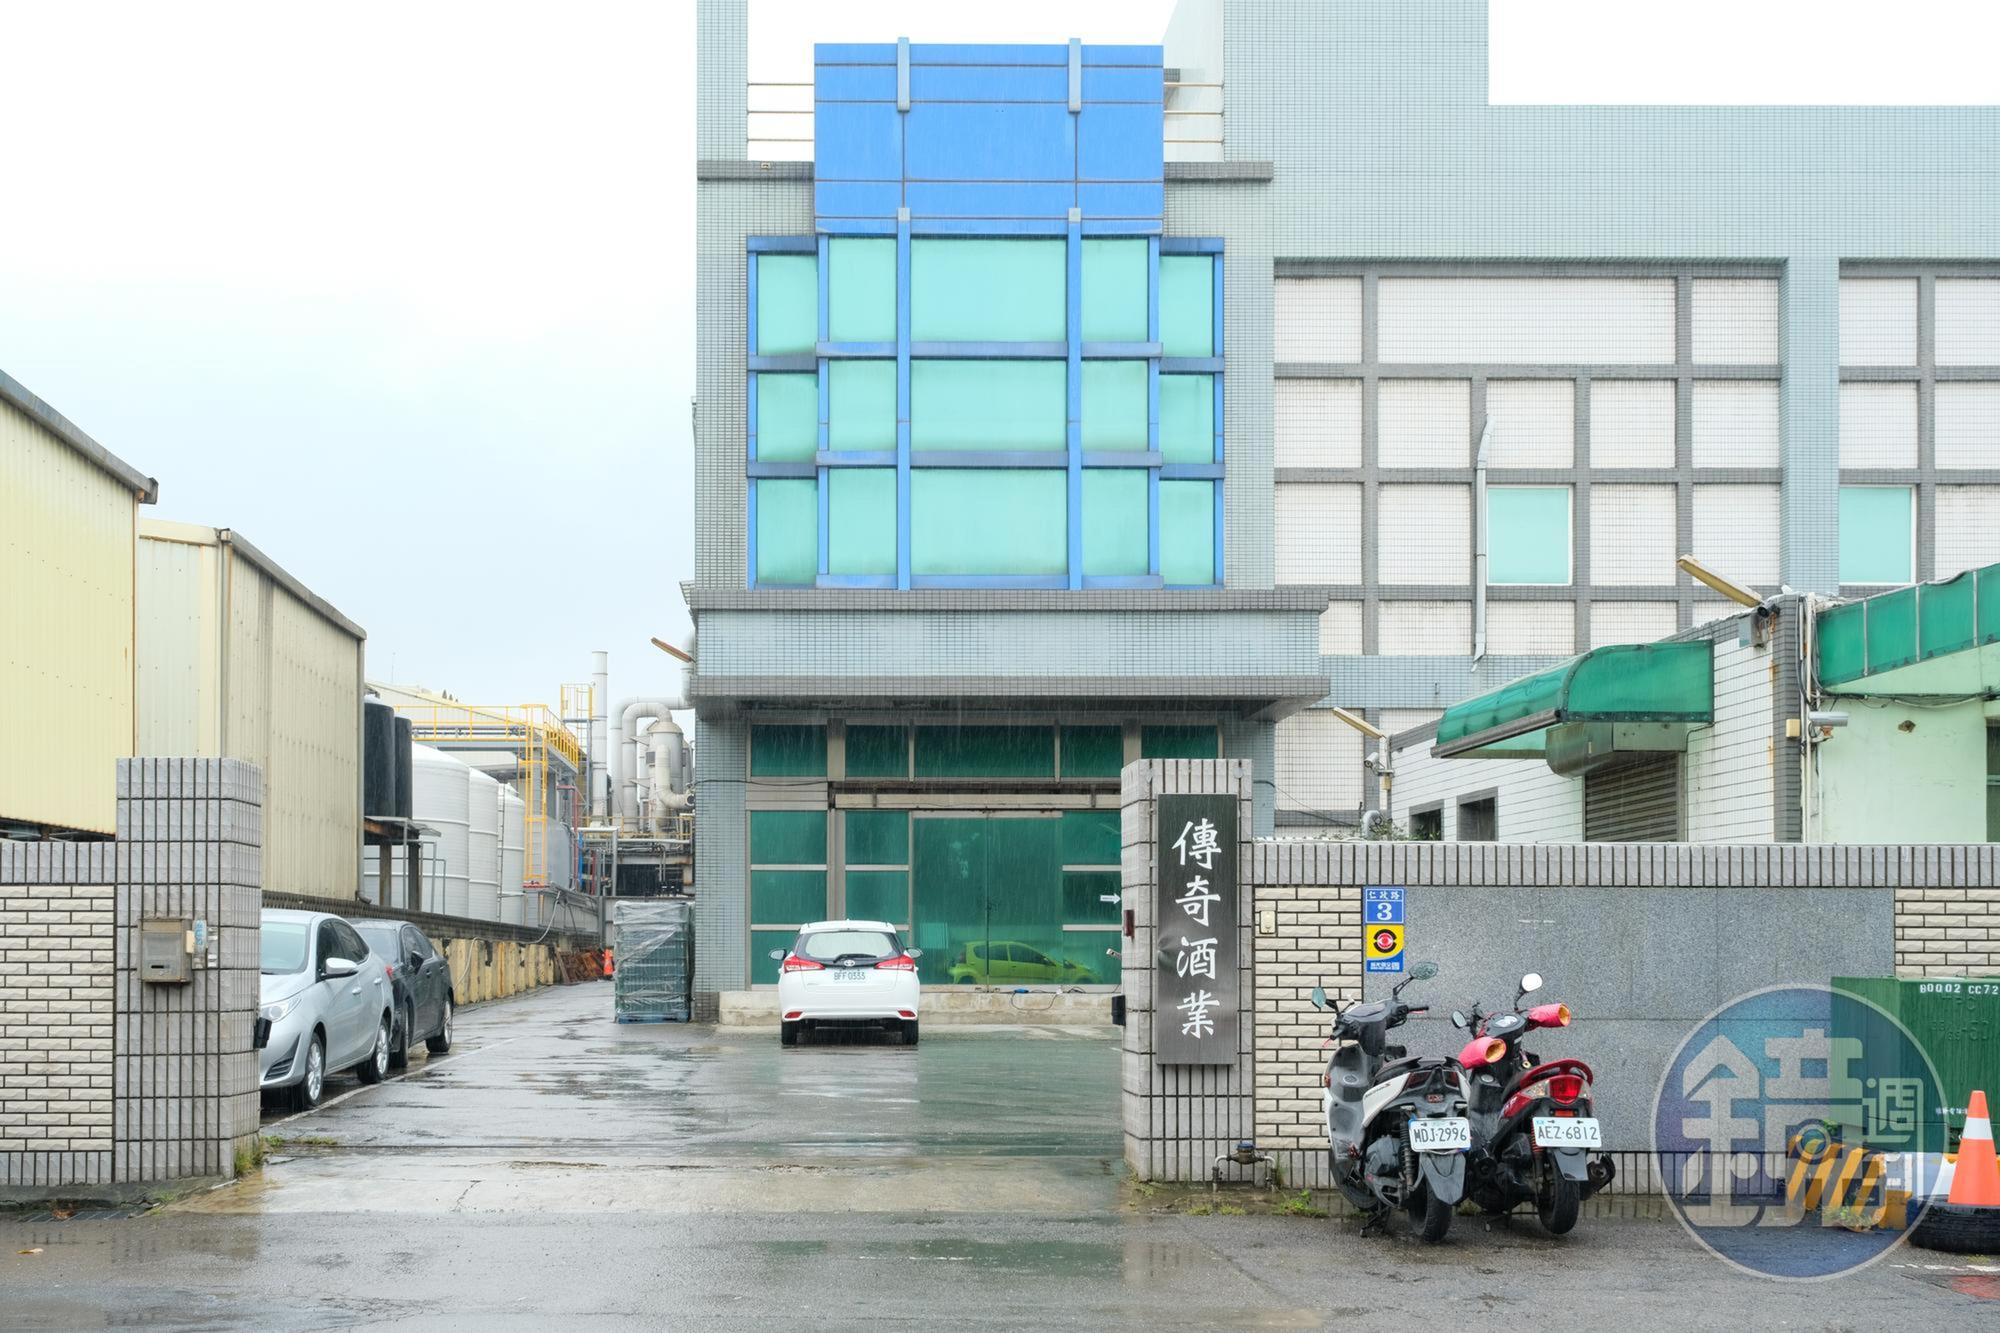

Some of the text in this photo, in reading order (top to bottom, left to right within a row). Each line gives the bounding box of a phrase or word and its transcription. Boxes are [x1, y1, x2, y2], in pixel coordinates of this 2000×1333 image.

[1172, 818, 1221, 1039] 傳奇酒業
[1377, 903, 1392, 920] 3
